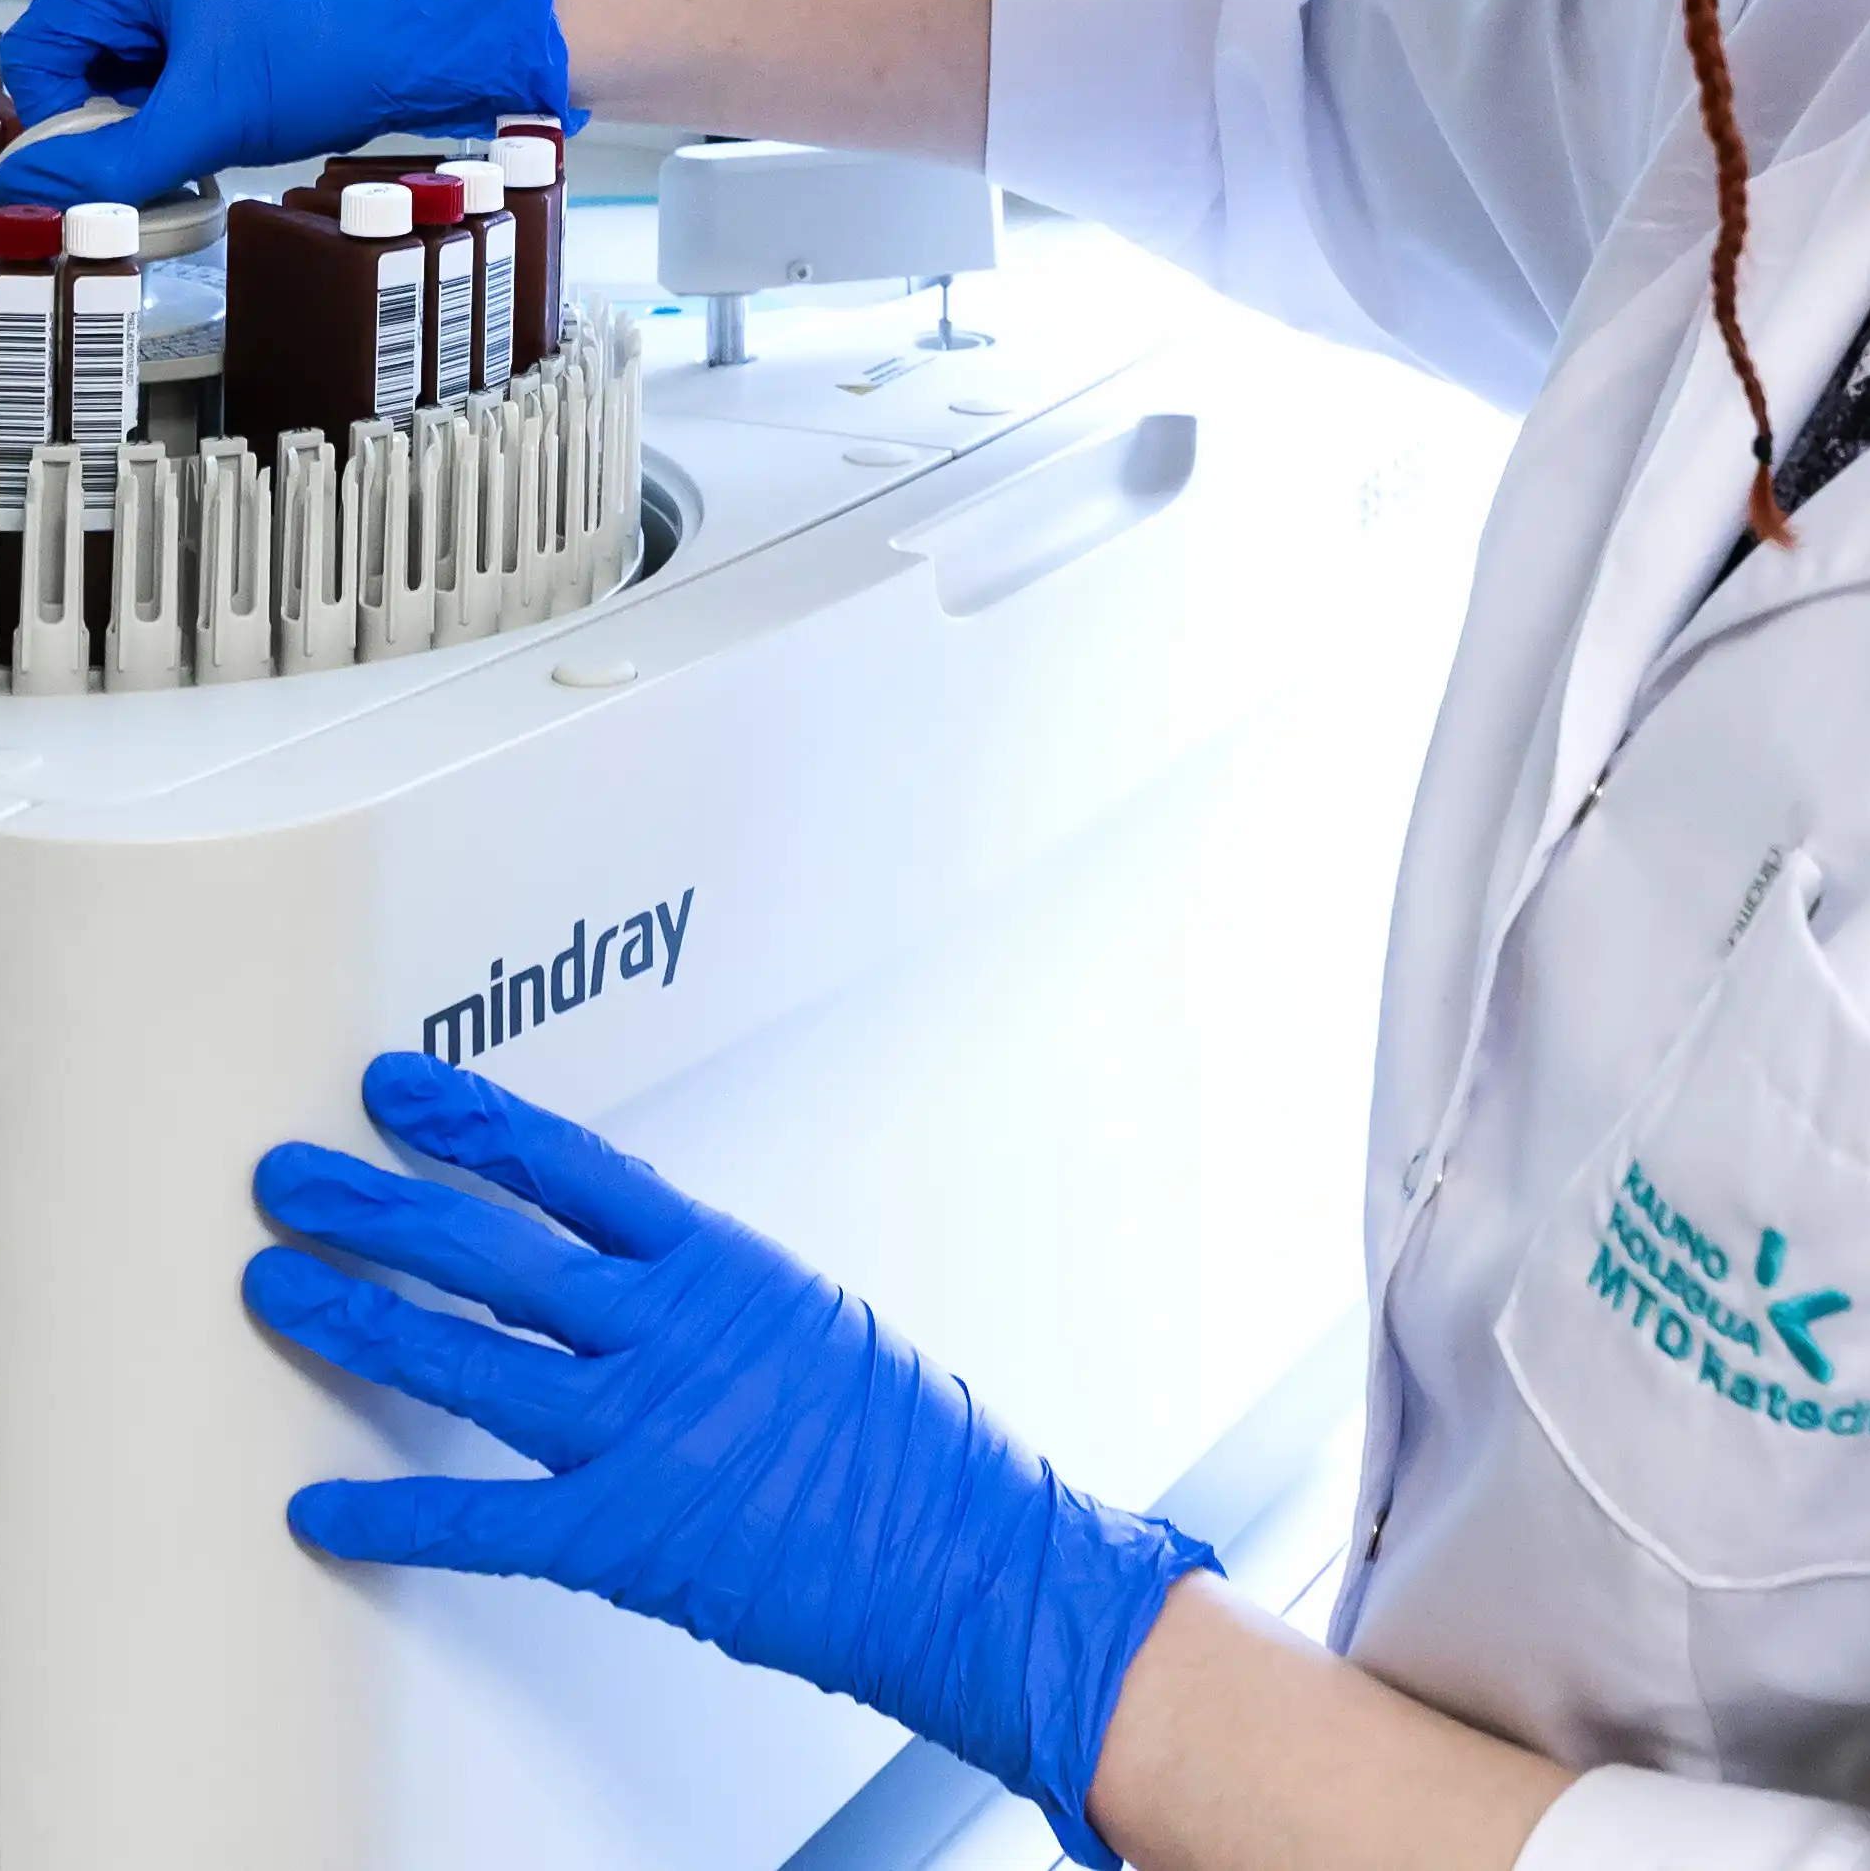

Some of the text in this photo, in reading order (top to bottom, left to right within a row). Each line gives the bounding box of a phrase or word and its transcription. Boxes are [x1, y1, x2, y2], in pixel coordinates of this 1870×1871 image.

[423, 886, 695, 1068] mindray
[1623, 1158, 1729, 1281] KAUNO
[1587, 1242, 1693, 1361] MTD
